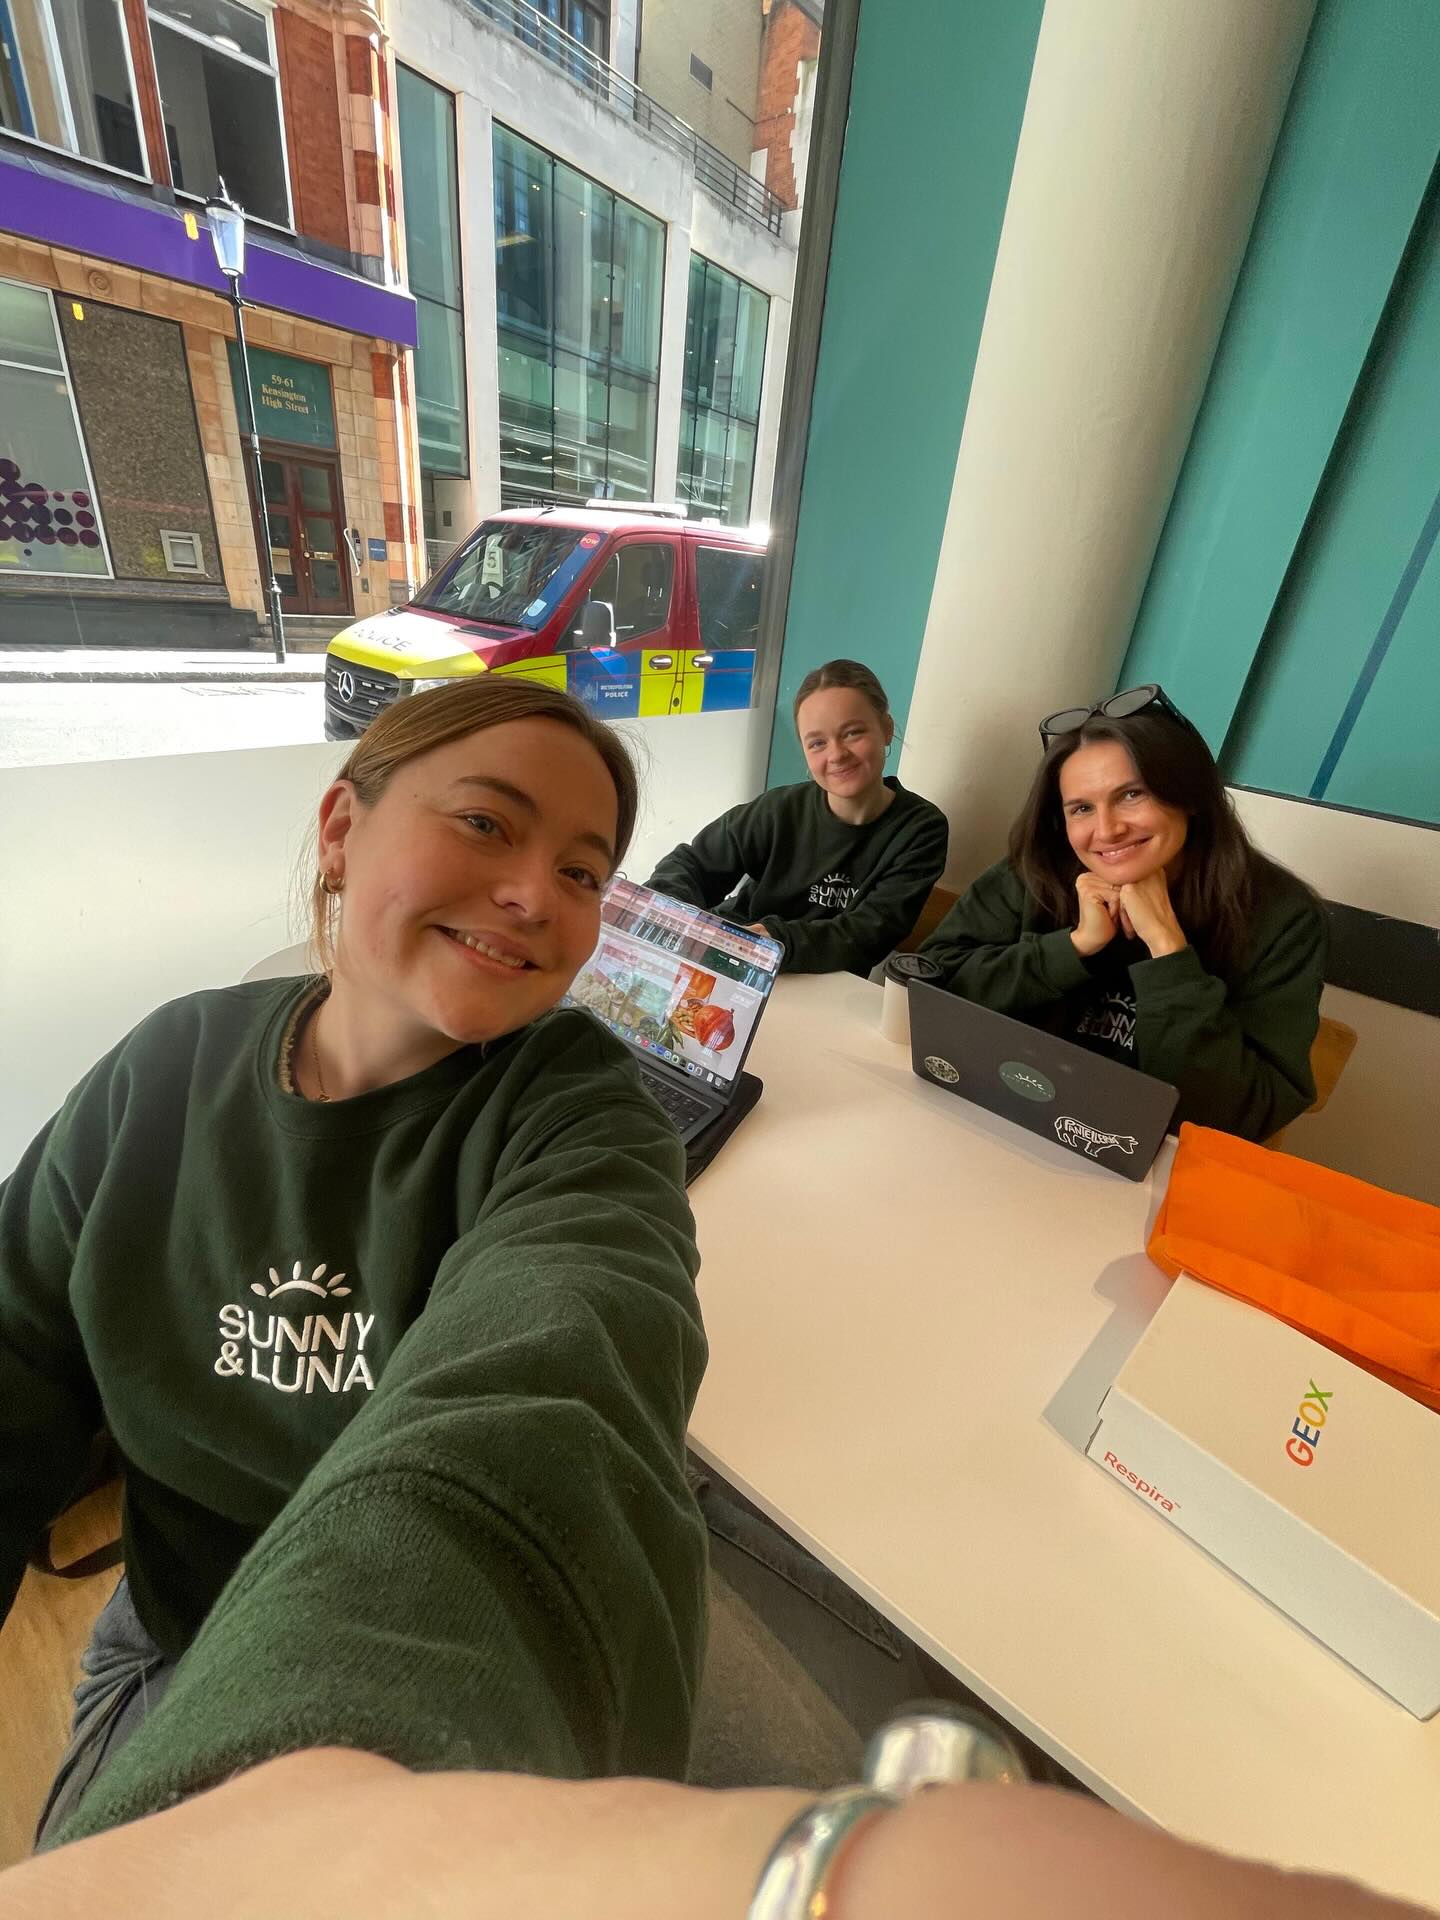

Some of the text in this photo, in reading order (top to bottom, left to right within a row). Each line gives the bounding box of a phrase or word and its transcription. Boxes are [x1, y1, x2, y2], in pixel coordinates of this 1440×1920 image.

[271, 374, 294, 388] 59-61
[261, 384, 307, 402] Kensington
[261, 396, 309, 415] High Street
[353, 627, 413, 652] LICE
[809, 884, 860, 899] SUNNY
[219, 1303, 375, 1353] SUNNY
[1286, 1378, 1334, 1467] GEOX
[1103, 1451, 1174, 1513] Respira
